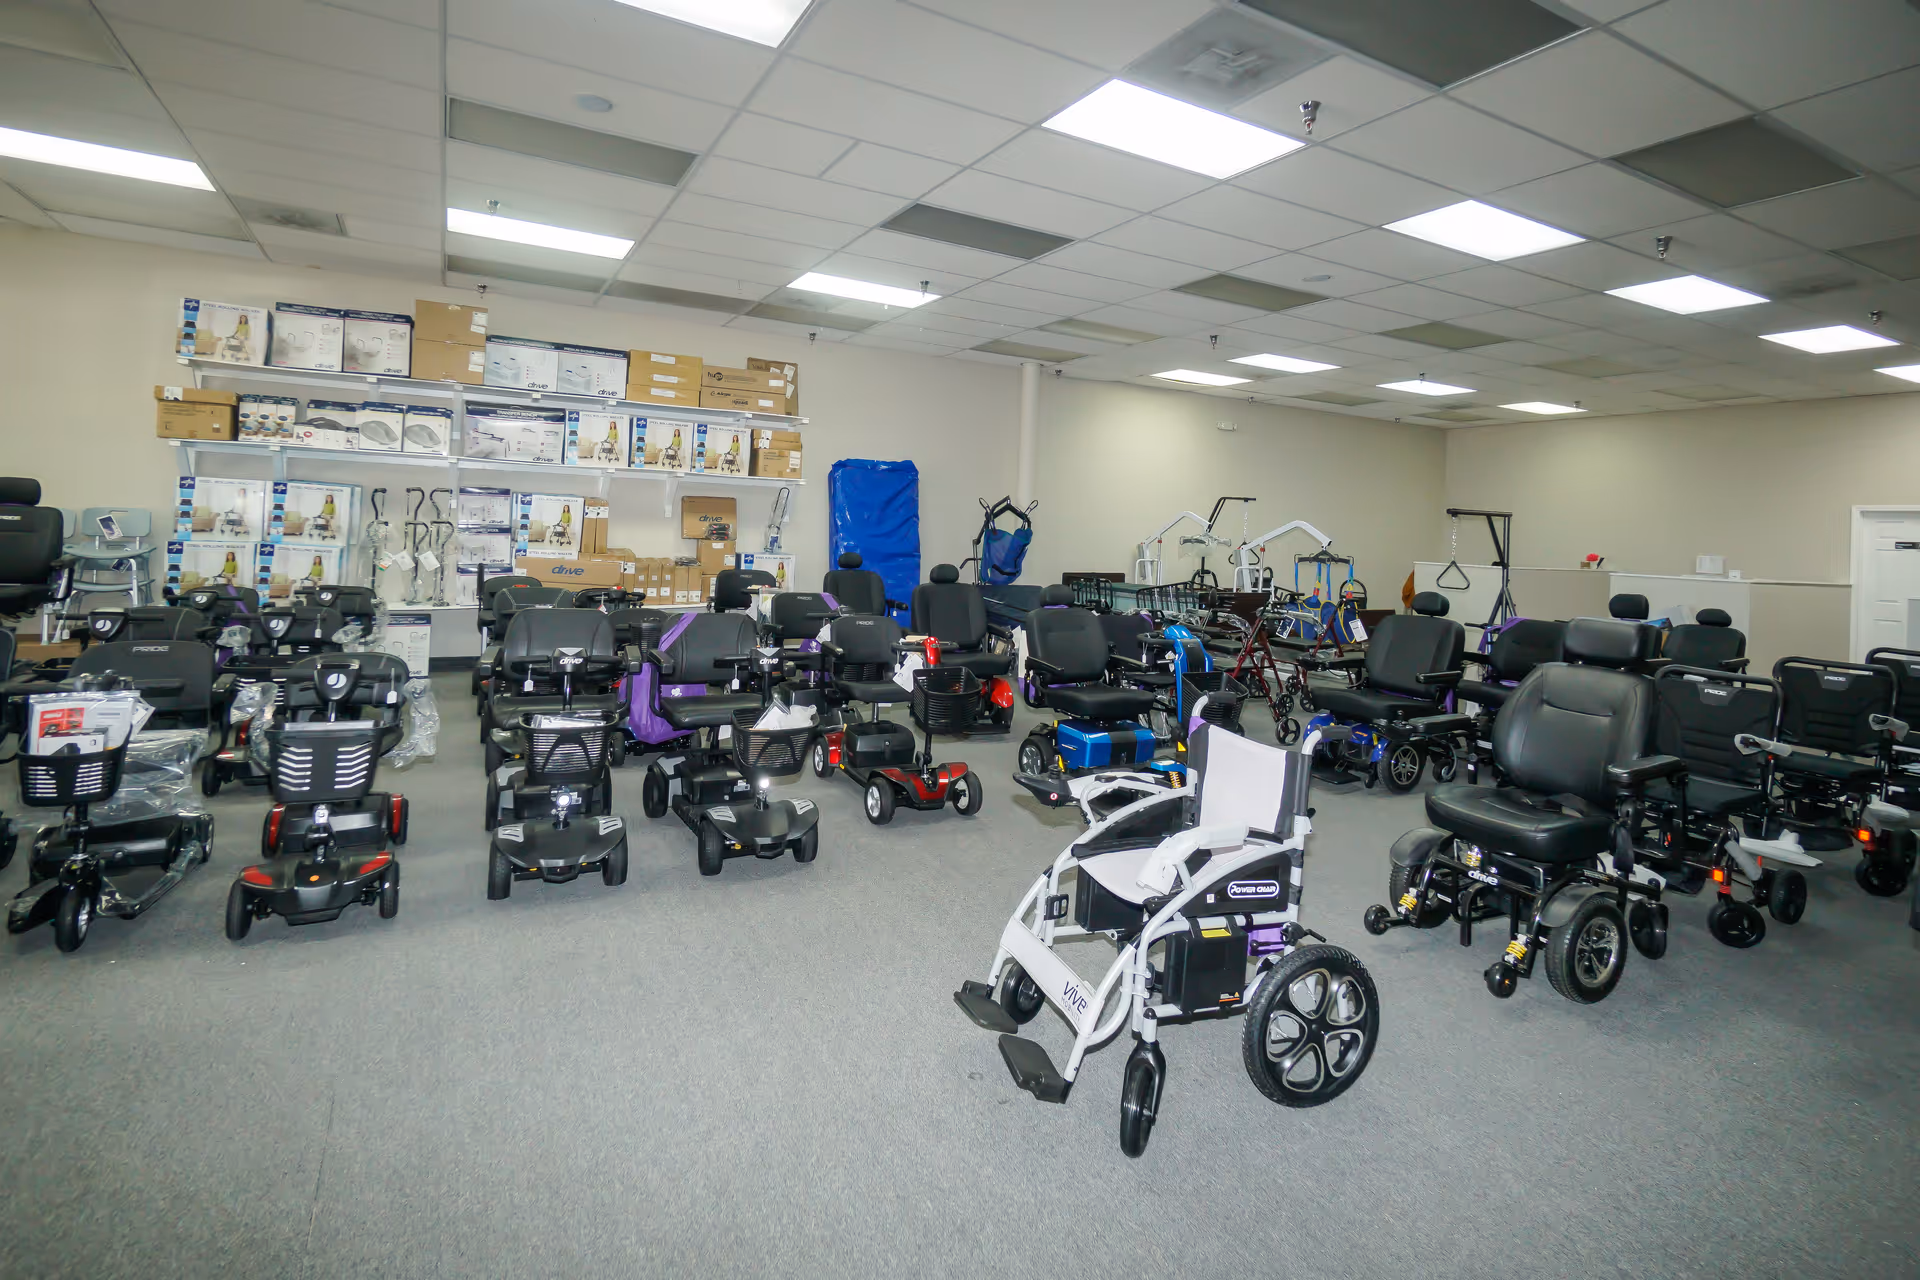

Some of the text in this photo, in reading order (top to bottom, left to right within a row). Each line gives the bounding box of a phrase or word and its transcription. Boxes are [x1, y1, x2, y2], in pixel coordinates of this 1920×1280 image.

[527, 381, 549, 390] drive
[597, 388, 618, 397] drive
[698, 515, 724, 523] drive
[551, 564, 585, 576] drive
[132, 645, 170, 653] PRIDE
[559, 656, 584, 665] drive
[759, 657, 779, 665] drive
[1704, 688, 1728, 697] PRIDE
[1467, 870, 1499, 886] drive
[1230, 884, 1277, 894] POWER CHAIR
